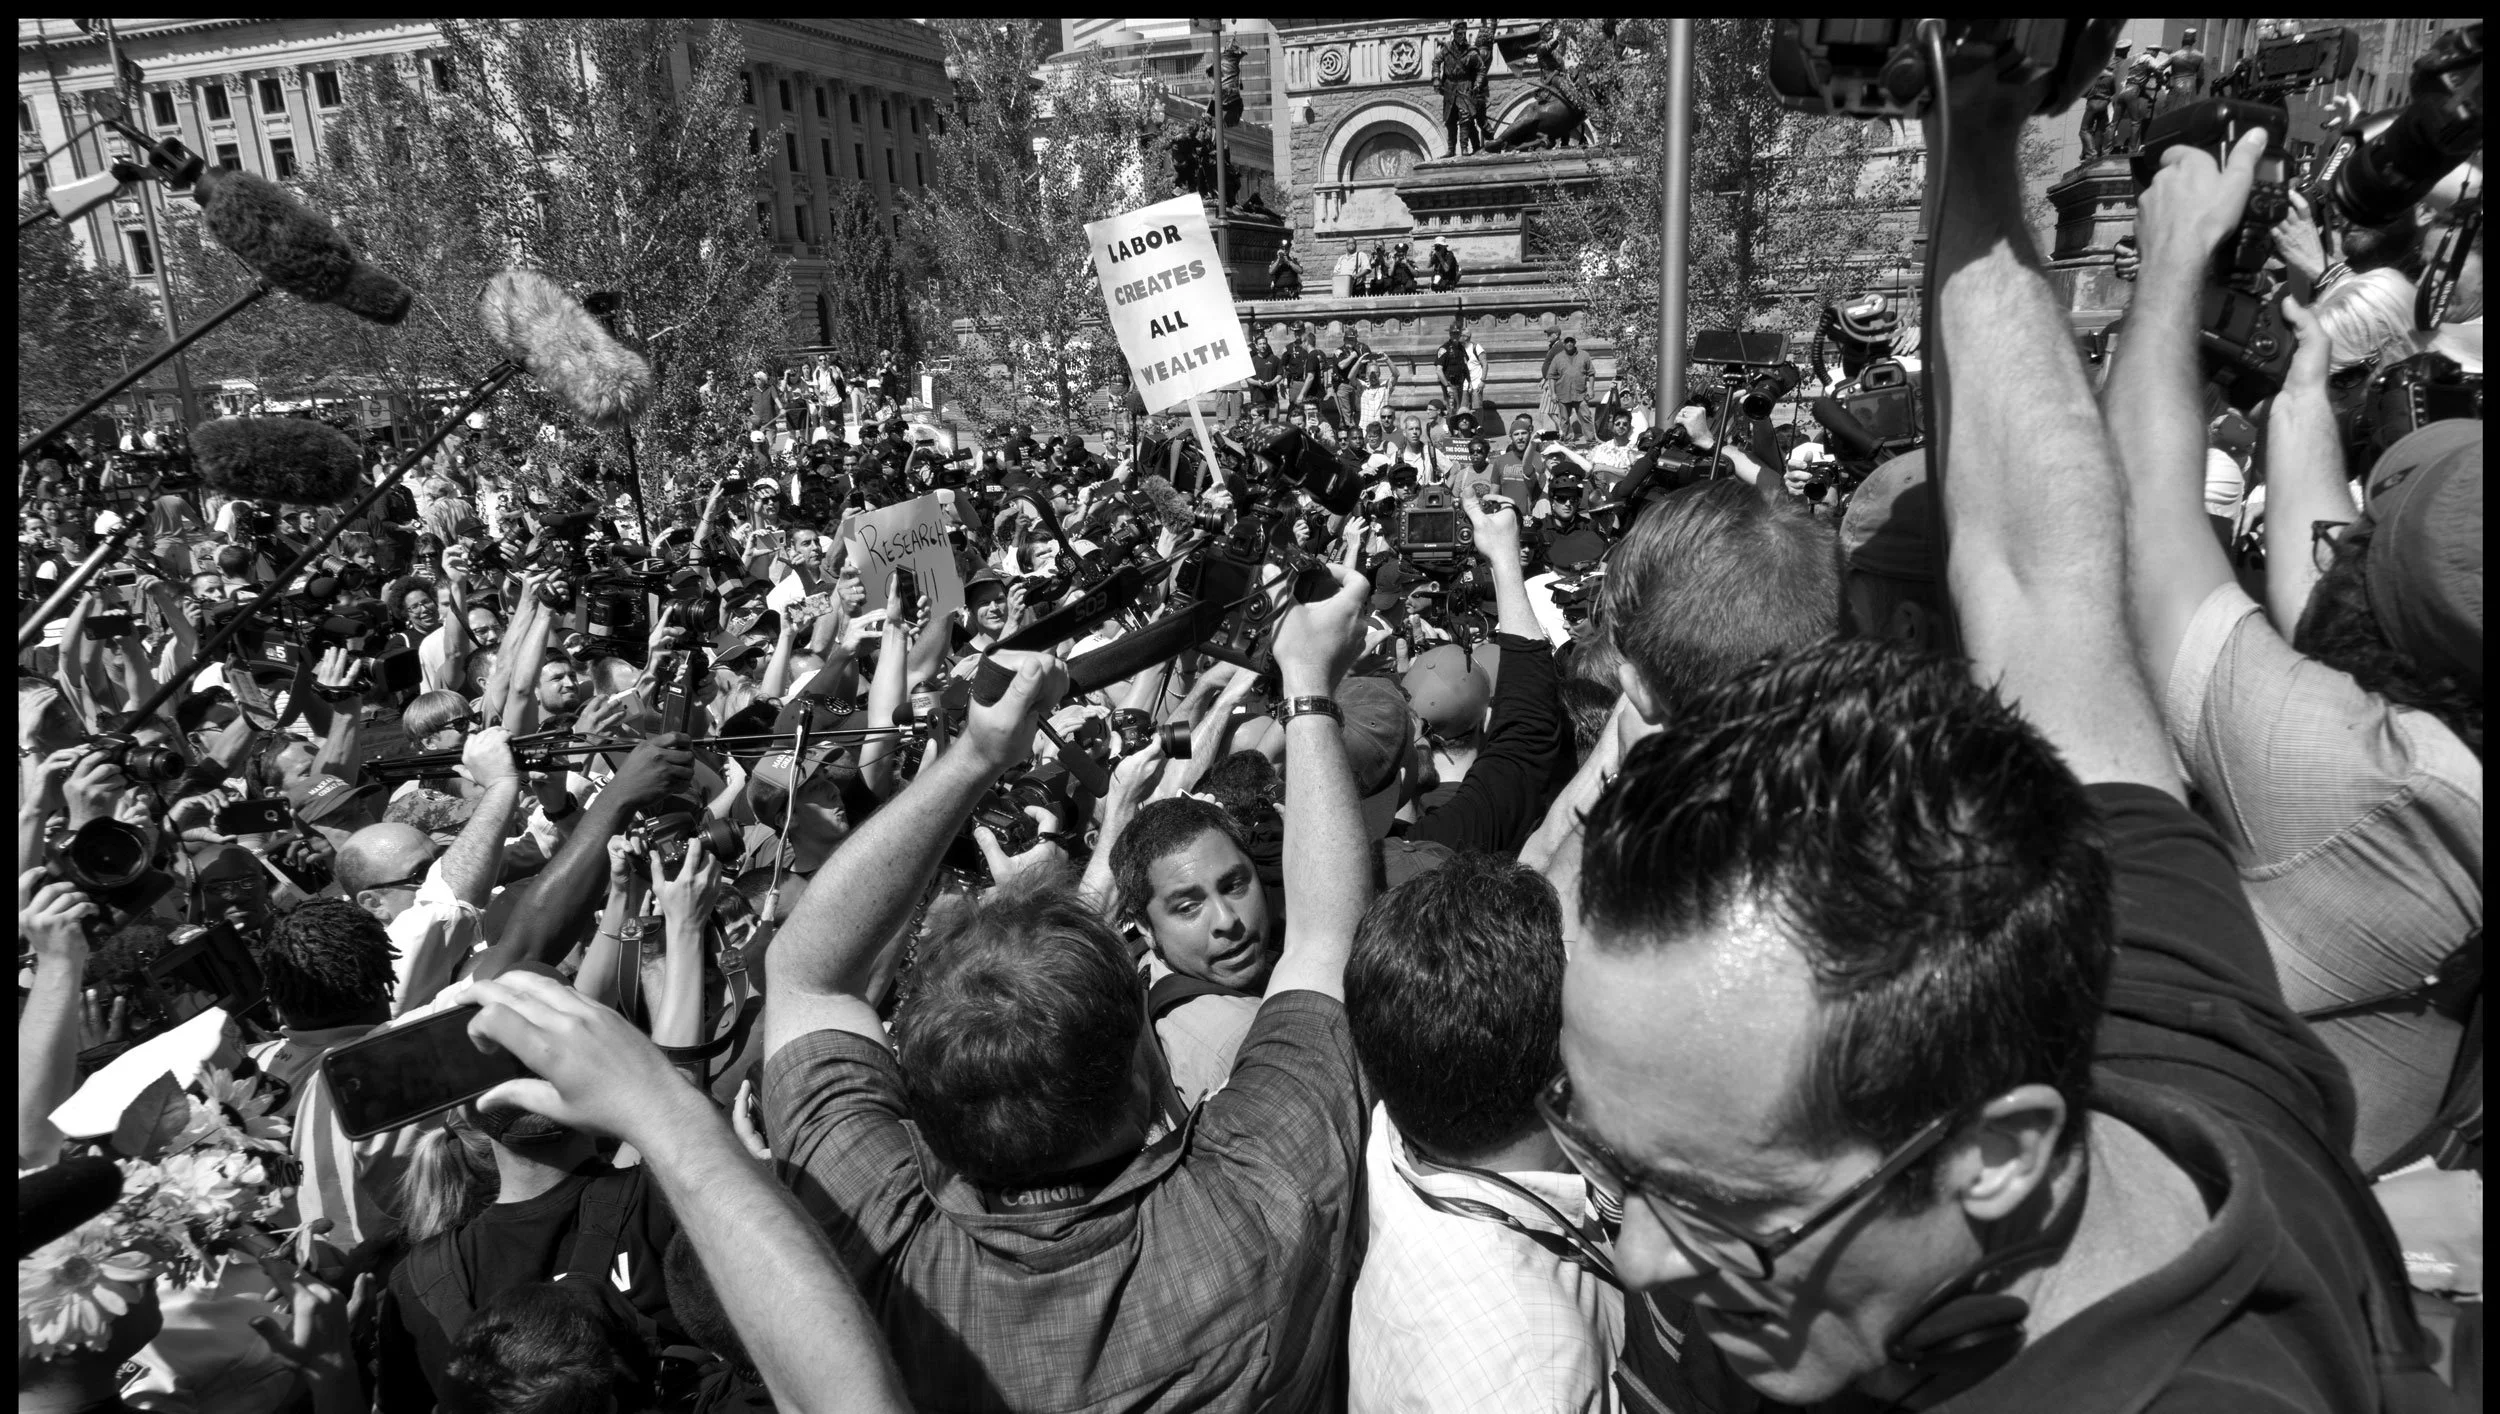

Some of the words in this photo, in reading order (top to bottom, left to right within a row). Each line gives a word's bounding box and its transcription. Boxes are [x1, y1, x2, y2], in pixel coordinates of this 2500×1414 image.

[1107, 224, 1182, 264] LABOR
[1114, 259, 1206, 306] CREATES
[2439, 281, 2455, 306] Nikon
[1150, 310, 1189, 339] ALL
[1140, 338, 1230, 386] WEALTH
[858, 518, 948, 574] RESEARCH
[275, 645, 287, 659] 5
[1000, 1182, 1085, 1208] Canon
